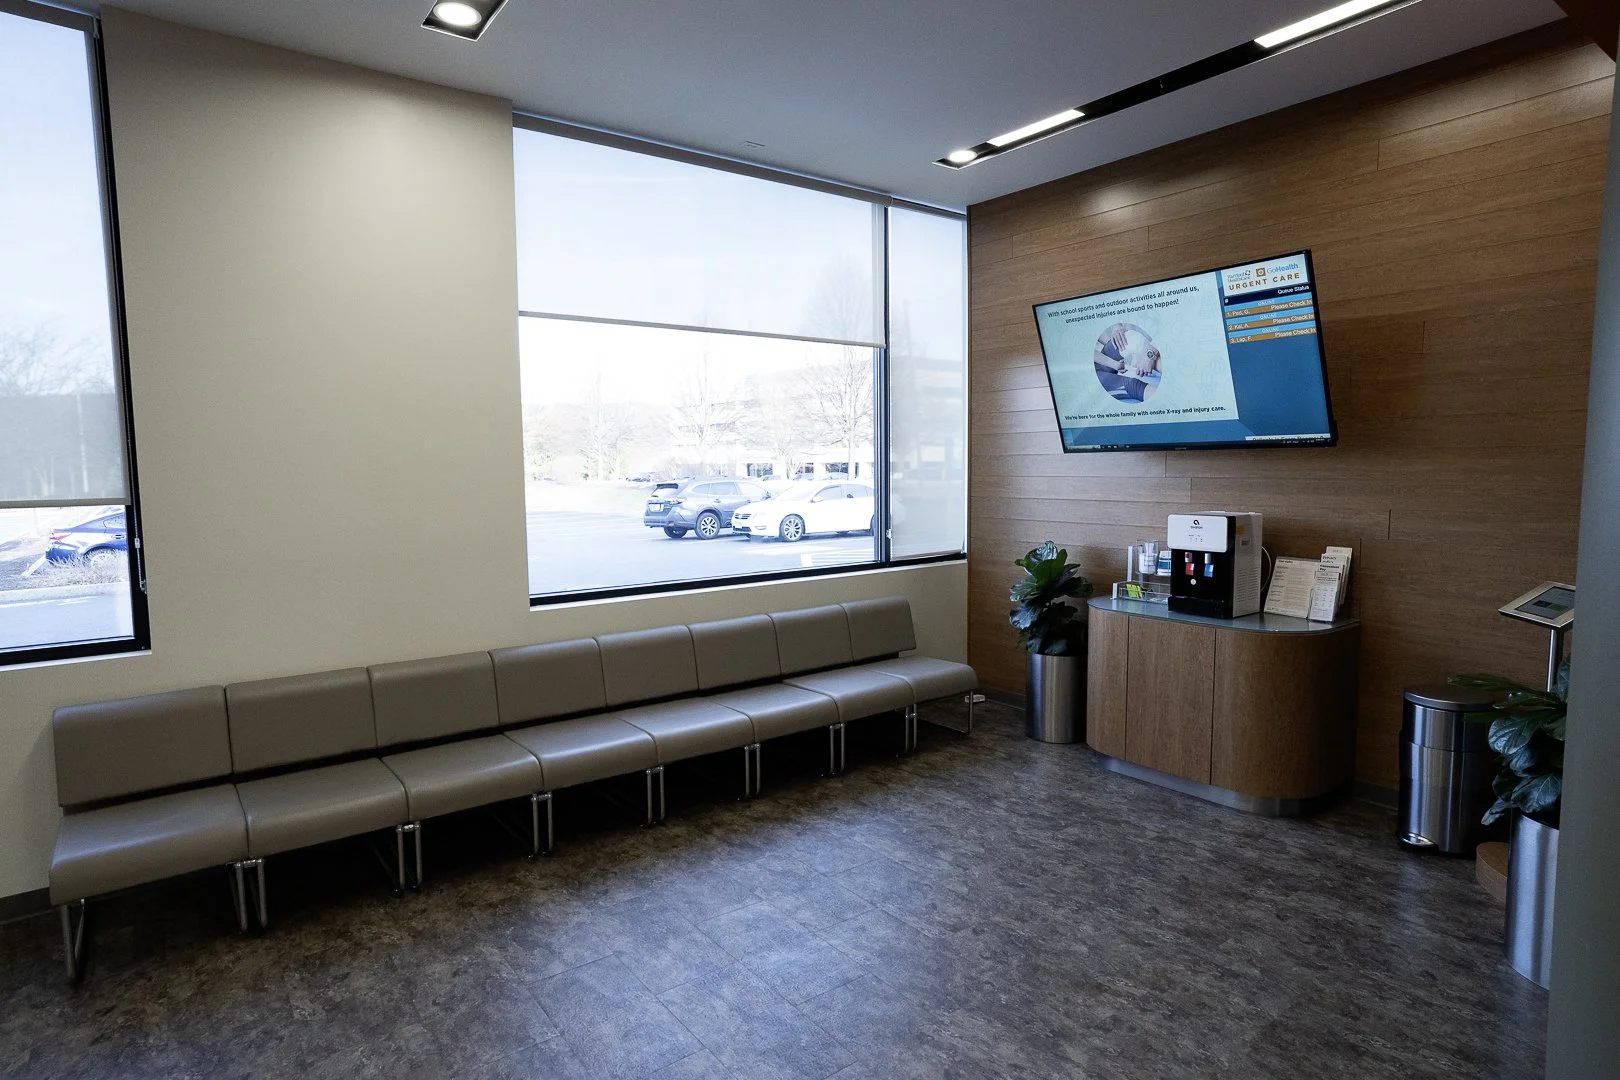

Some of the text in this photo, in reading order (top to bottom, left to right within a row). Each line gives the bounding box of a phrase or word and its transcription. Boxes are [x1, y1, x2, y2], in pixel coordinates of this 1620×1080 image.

[1266, 262, 1298, 274] GoHealth
[1229, 272, 1300, 290] URGENT CARE
[1106, 298, 1128, 307] outdoor
[1130, 293, 1156, 303] activities
[1166, 286, 1188, 296] around
[1066, 313, 1095, 323] unexpected
[1096, 310, 1116, 319] injuries
[1126, 304, 1145, 313] bound
[1154, 298, 1179, 308] happen!
